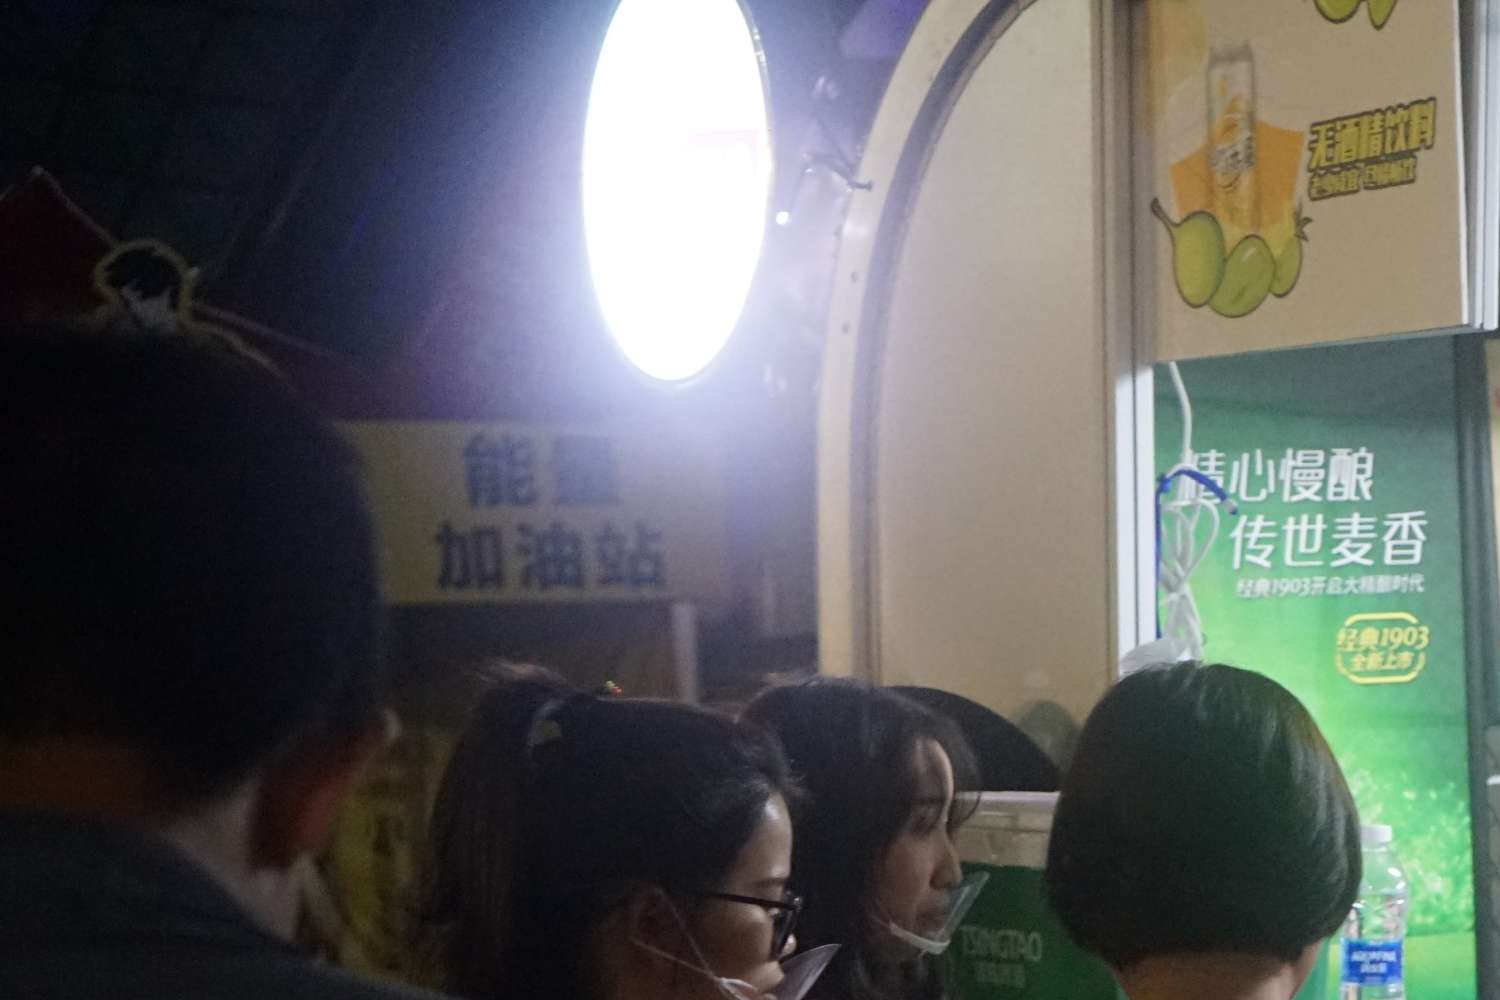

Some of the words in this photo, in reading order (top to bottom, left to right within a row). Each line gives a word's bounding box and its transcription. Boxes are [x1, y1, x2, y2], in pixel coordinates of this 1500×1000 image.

[1180, 447, 1375, 502] 精心慢酿
[436, 519, 665, 589] 加油站
[1229, 510, 1429, 570] 传世麦香
